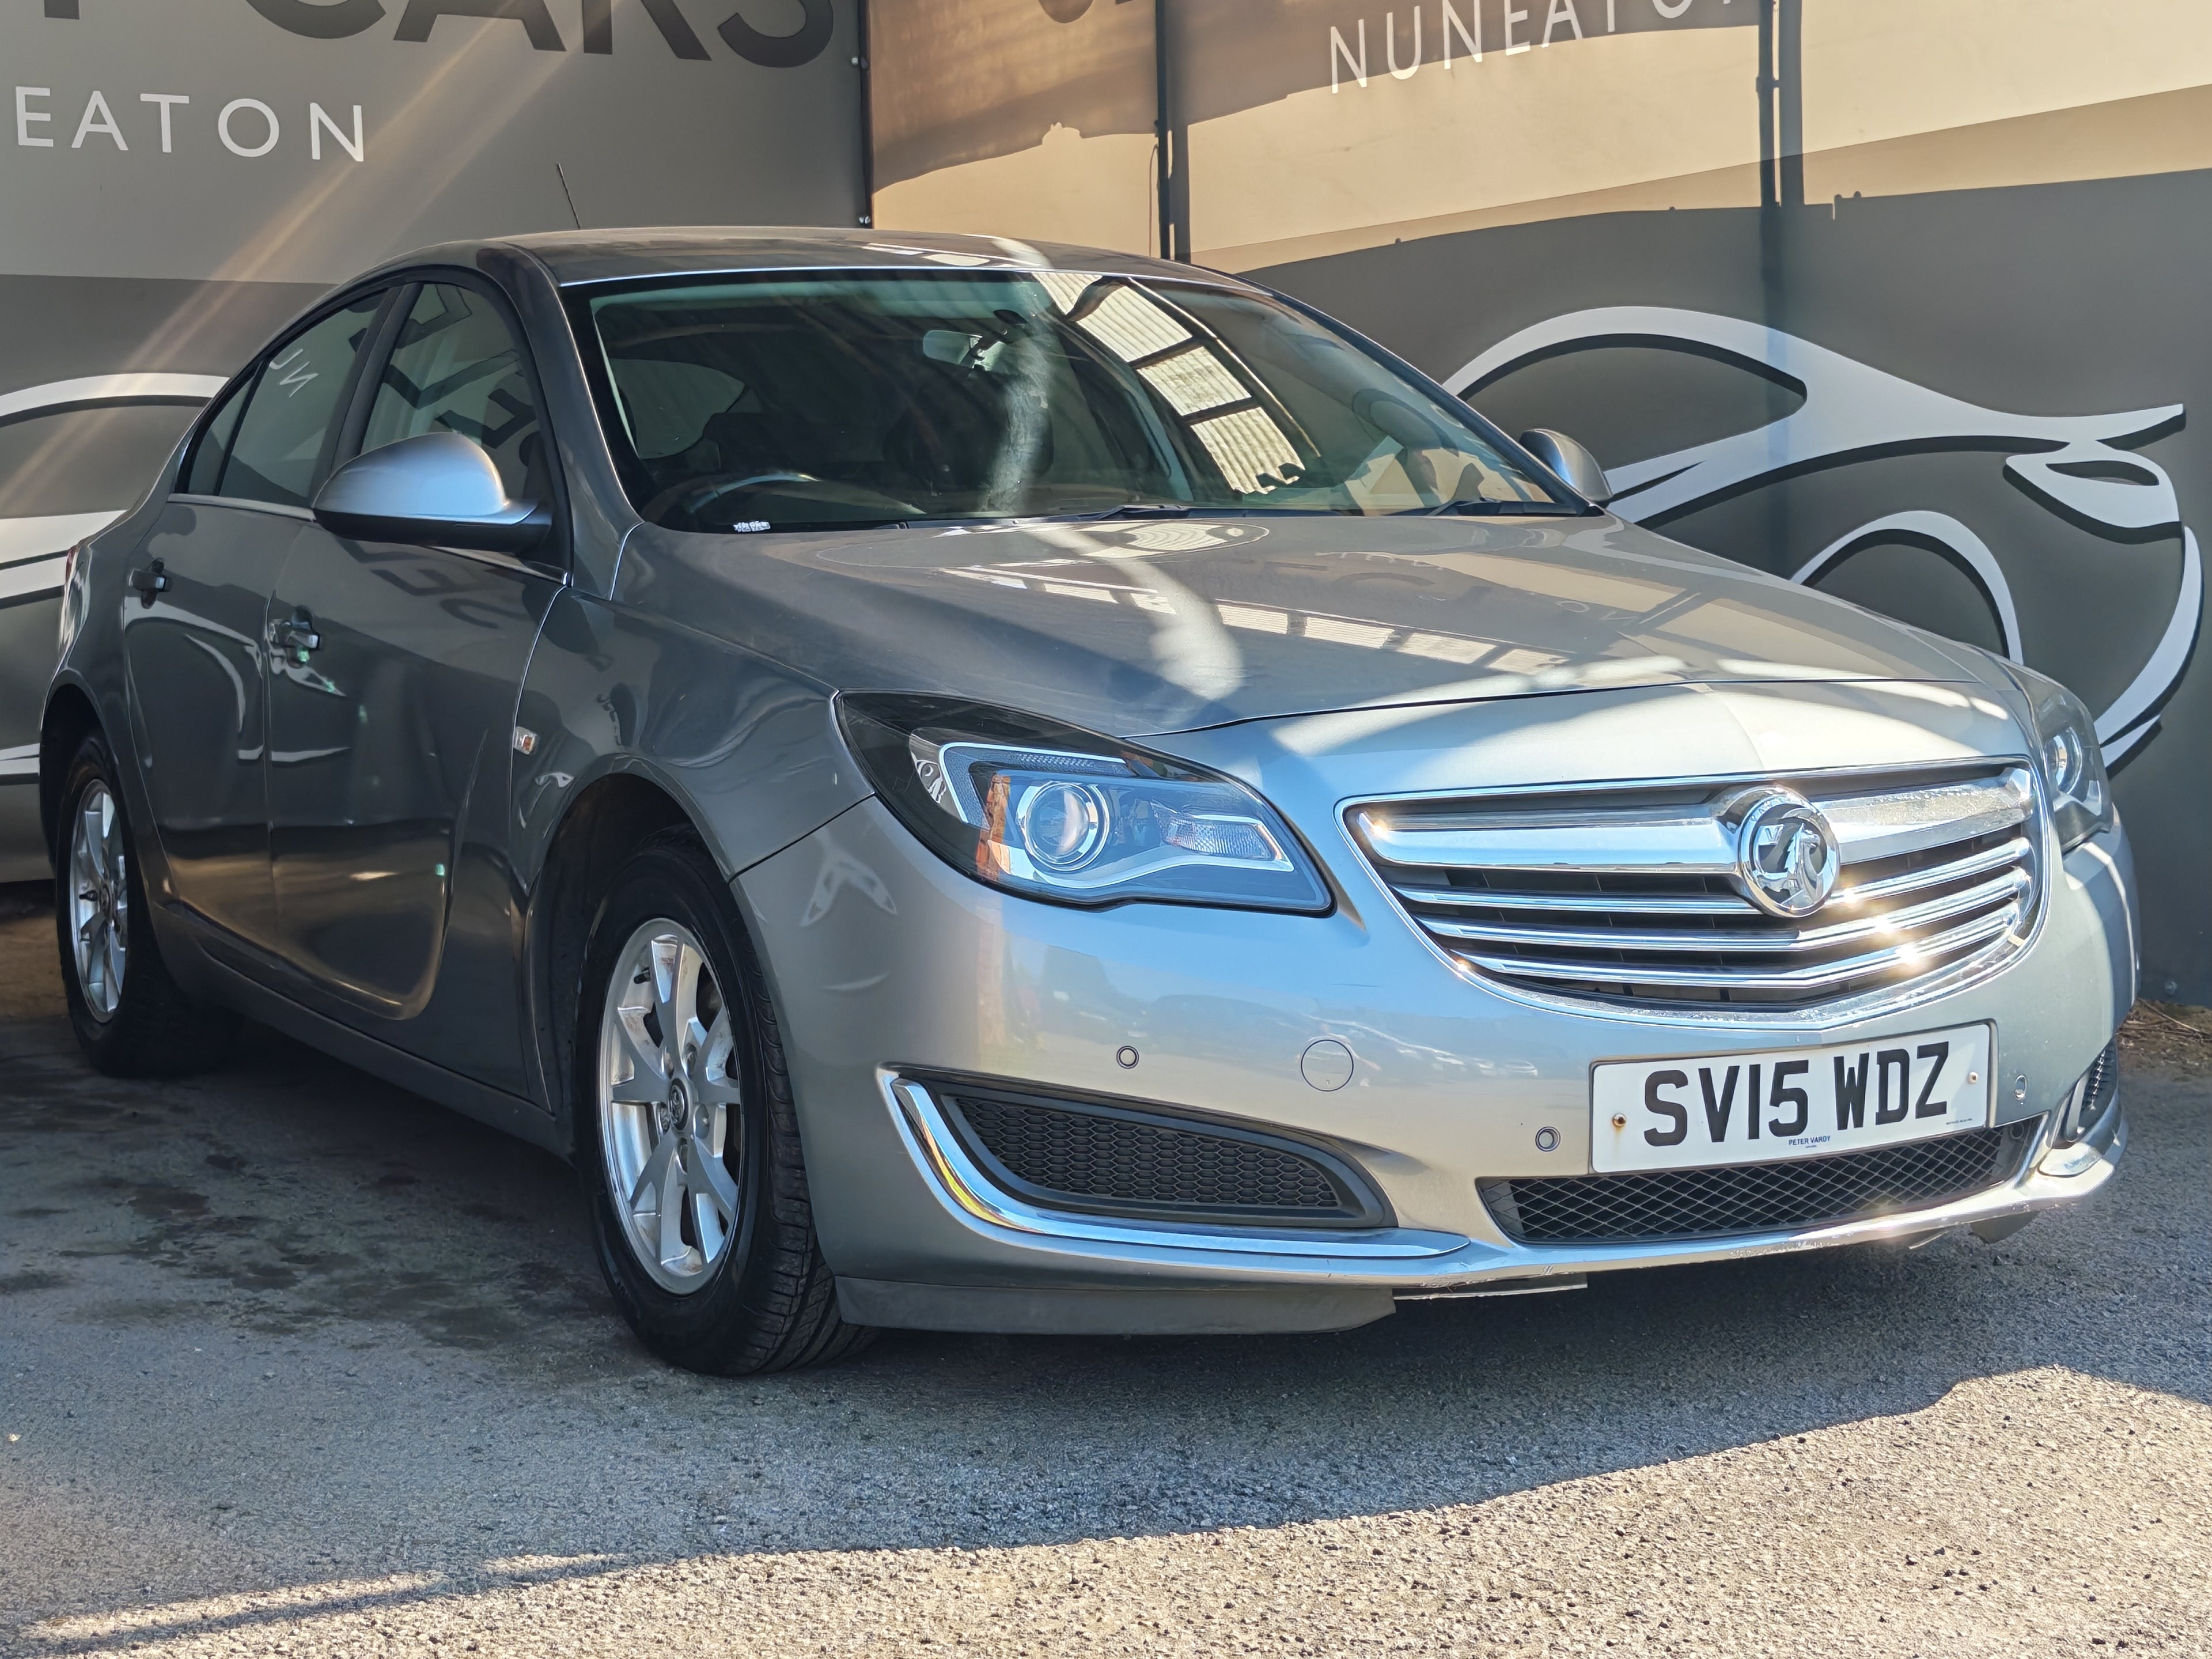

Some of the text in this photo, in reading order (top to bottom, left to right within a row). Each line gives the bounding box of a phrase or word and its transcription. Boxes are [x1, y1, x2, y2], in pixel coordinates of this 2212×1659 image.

[1331, 0, 1736, 94] NUNEA
[16, 86, 364, 162] EATON
[1644, 1041, 1949, 1147] SV15 WDZ
[1789, 1135, 1831, 1146] PETER VARDY
